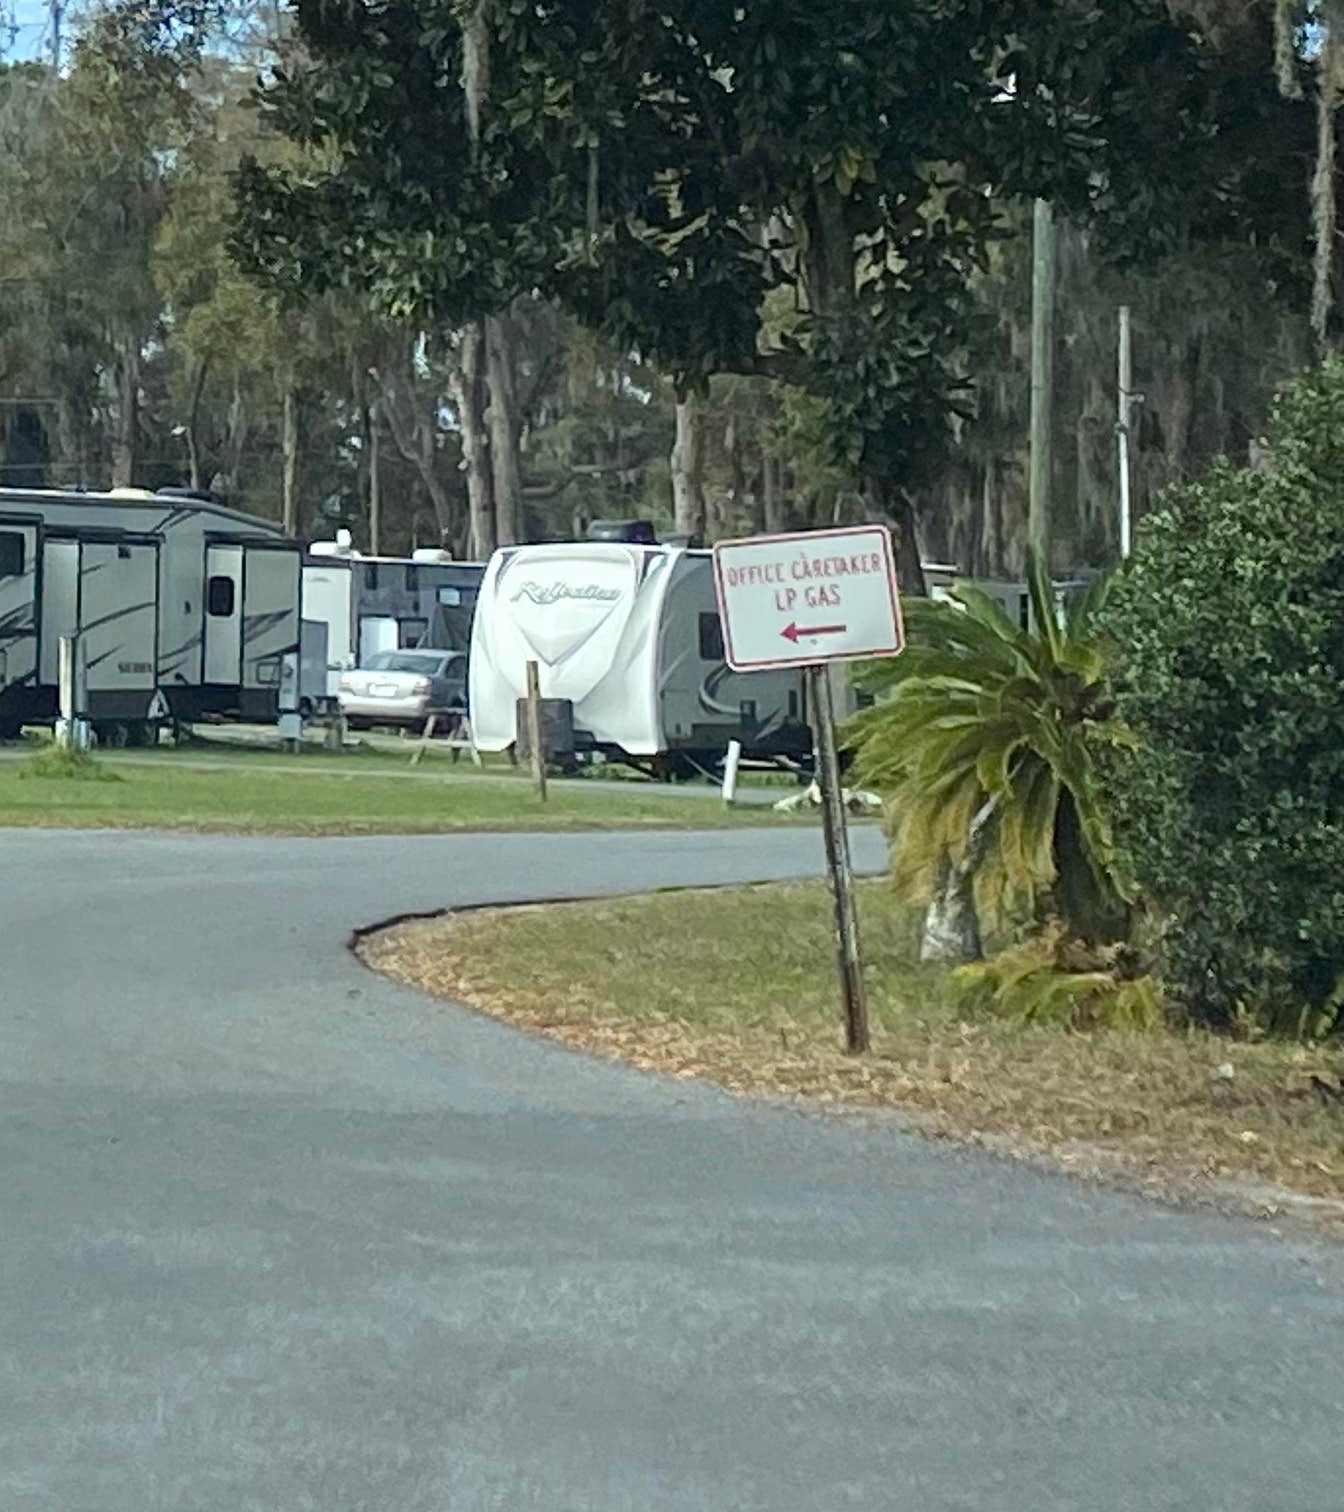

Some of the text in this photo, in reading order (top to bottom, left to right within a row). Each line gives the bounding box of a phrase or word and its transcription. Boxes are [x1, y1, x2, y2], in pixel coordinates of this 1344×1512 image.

[727, 552, 882, 587] OFFICE CARETAKER
[775, 584, 841, 611] LP GAS
